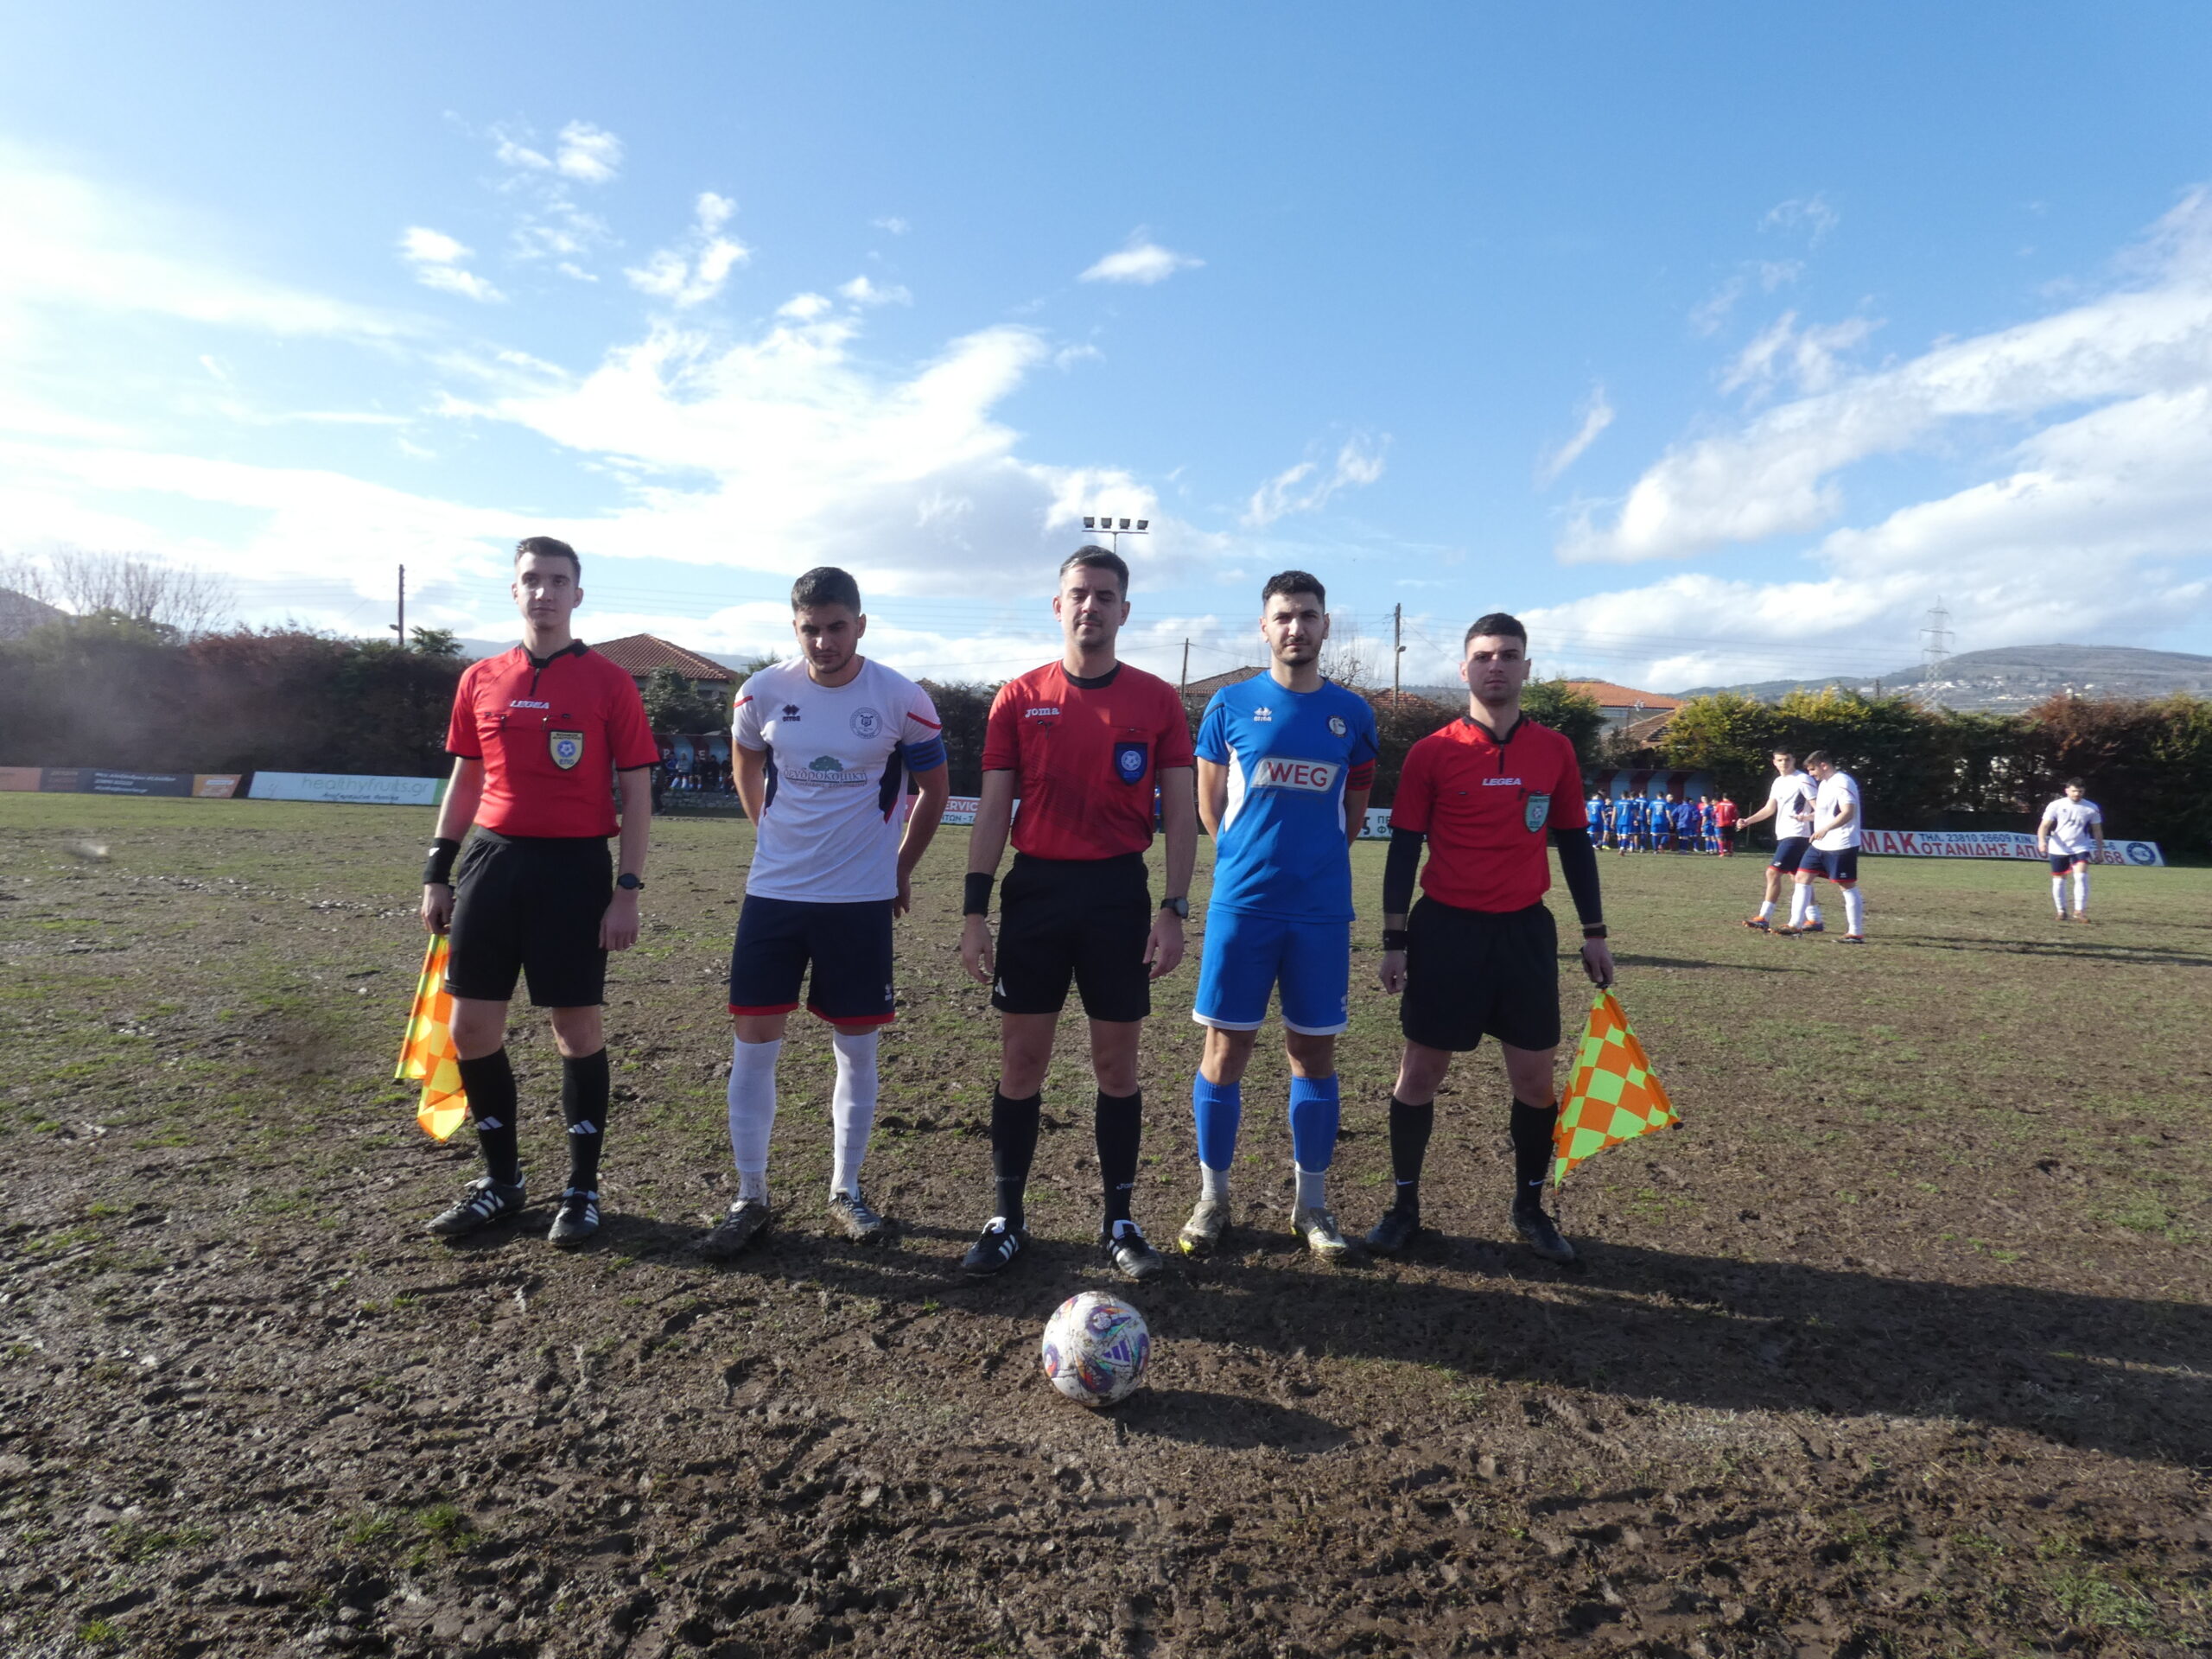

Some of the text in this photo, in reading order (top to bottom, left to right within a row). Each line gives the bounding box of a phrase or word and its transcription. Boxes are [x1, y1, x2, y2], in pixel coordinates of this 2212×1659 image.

[510, 700, 550, 709] LEGEA
[1267, 761, 1328, 787] WEG
[302, 777, 428, 797] healthyfruits.gr
[1482, 778, 1522, 786] LEGEA
[945, 800, 979, 811] ERVIC
